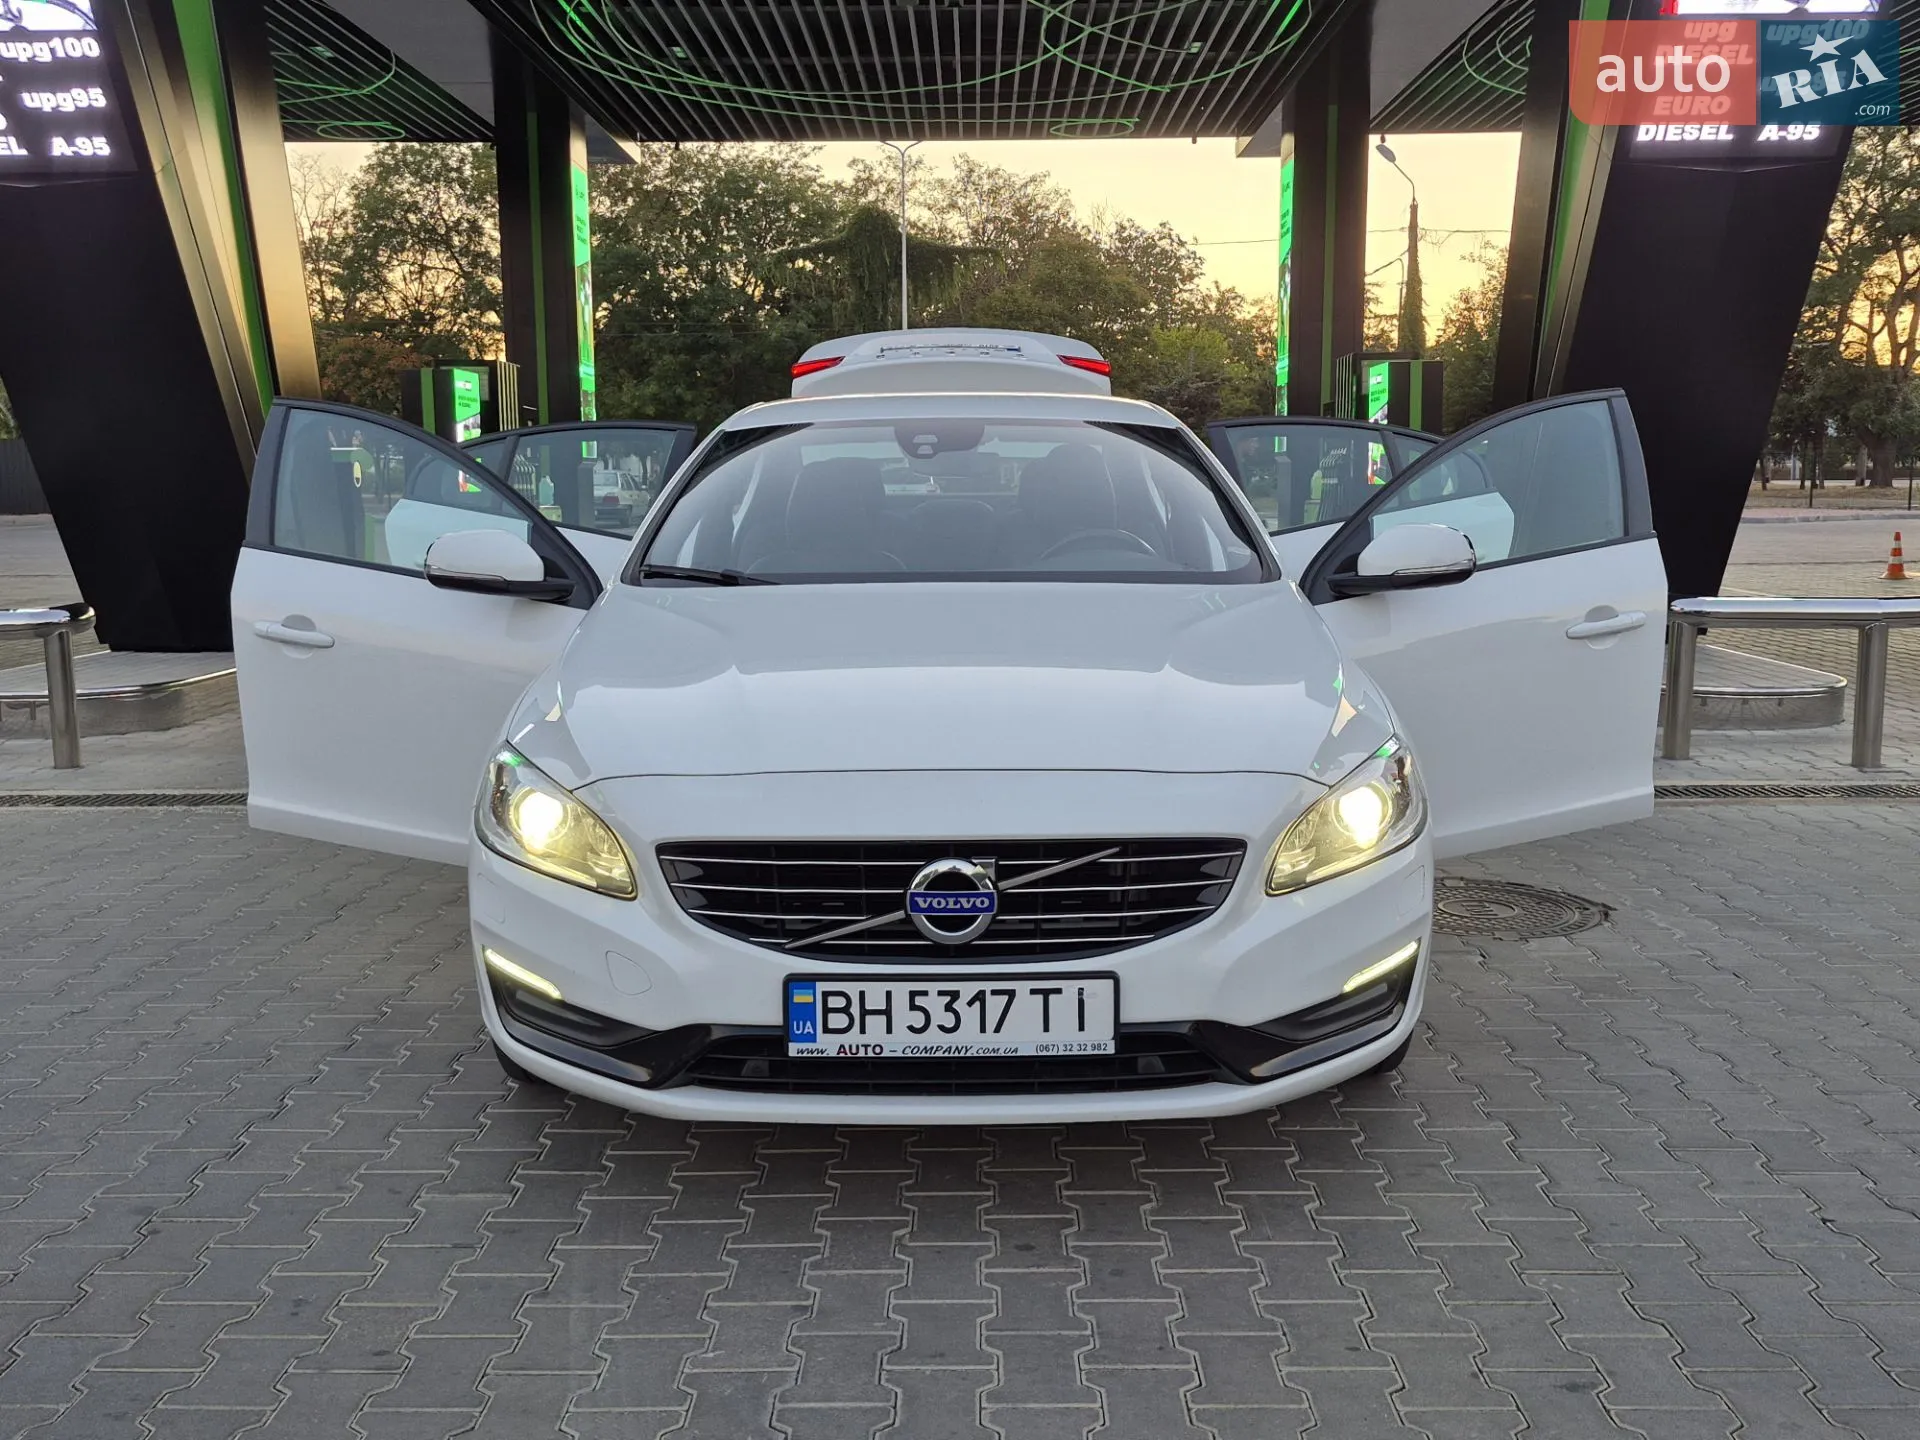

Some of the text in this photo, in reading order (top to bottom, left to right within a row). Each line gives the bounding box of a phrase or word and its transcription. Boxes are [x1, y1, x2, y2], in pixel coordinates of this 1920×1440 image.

[1684, 21, 1738, 43] upg
[0, 37, 100, 62] upg100
[21, 88, 107, 112] upg95
[1653, 96, 1730, 116] EURO
[1636, 123, 1734, 142] DIESEL
[1757, 123, 1822, 142] A-95
[51, 136, 111, 157] A-95
[914, 897, 990, 908] VOLVO
[821, 990, 893, 1035] BH
[906, 989, 1017, 1034] 5317
[793, 1021, 814, 1034] UA
[836, 1043, 884, 1056] AUTO
[1035, 1042, 1108, 1054] (067) 32 32 982
